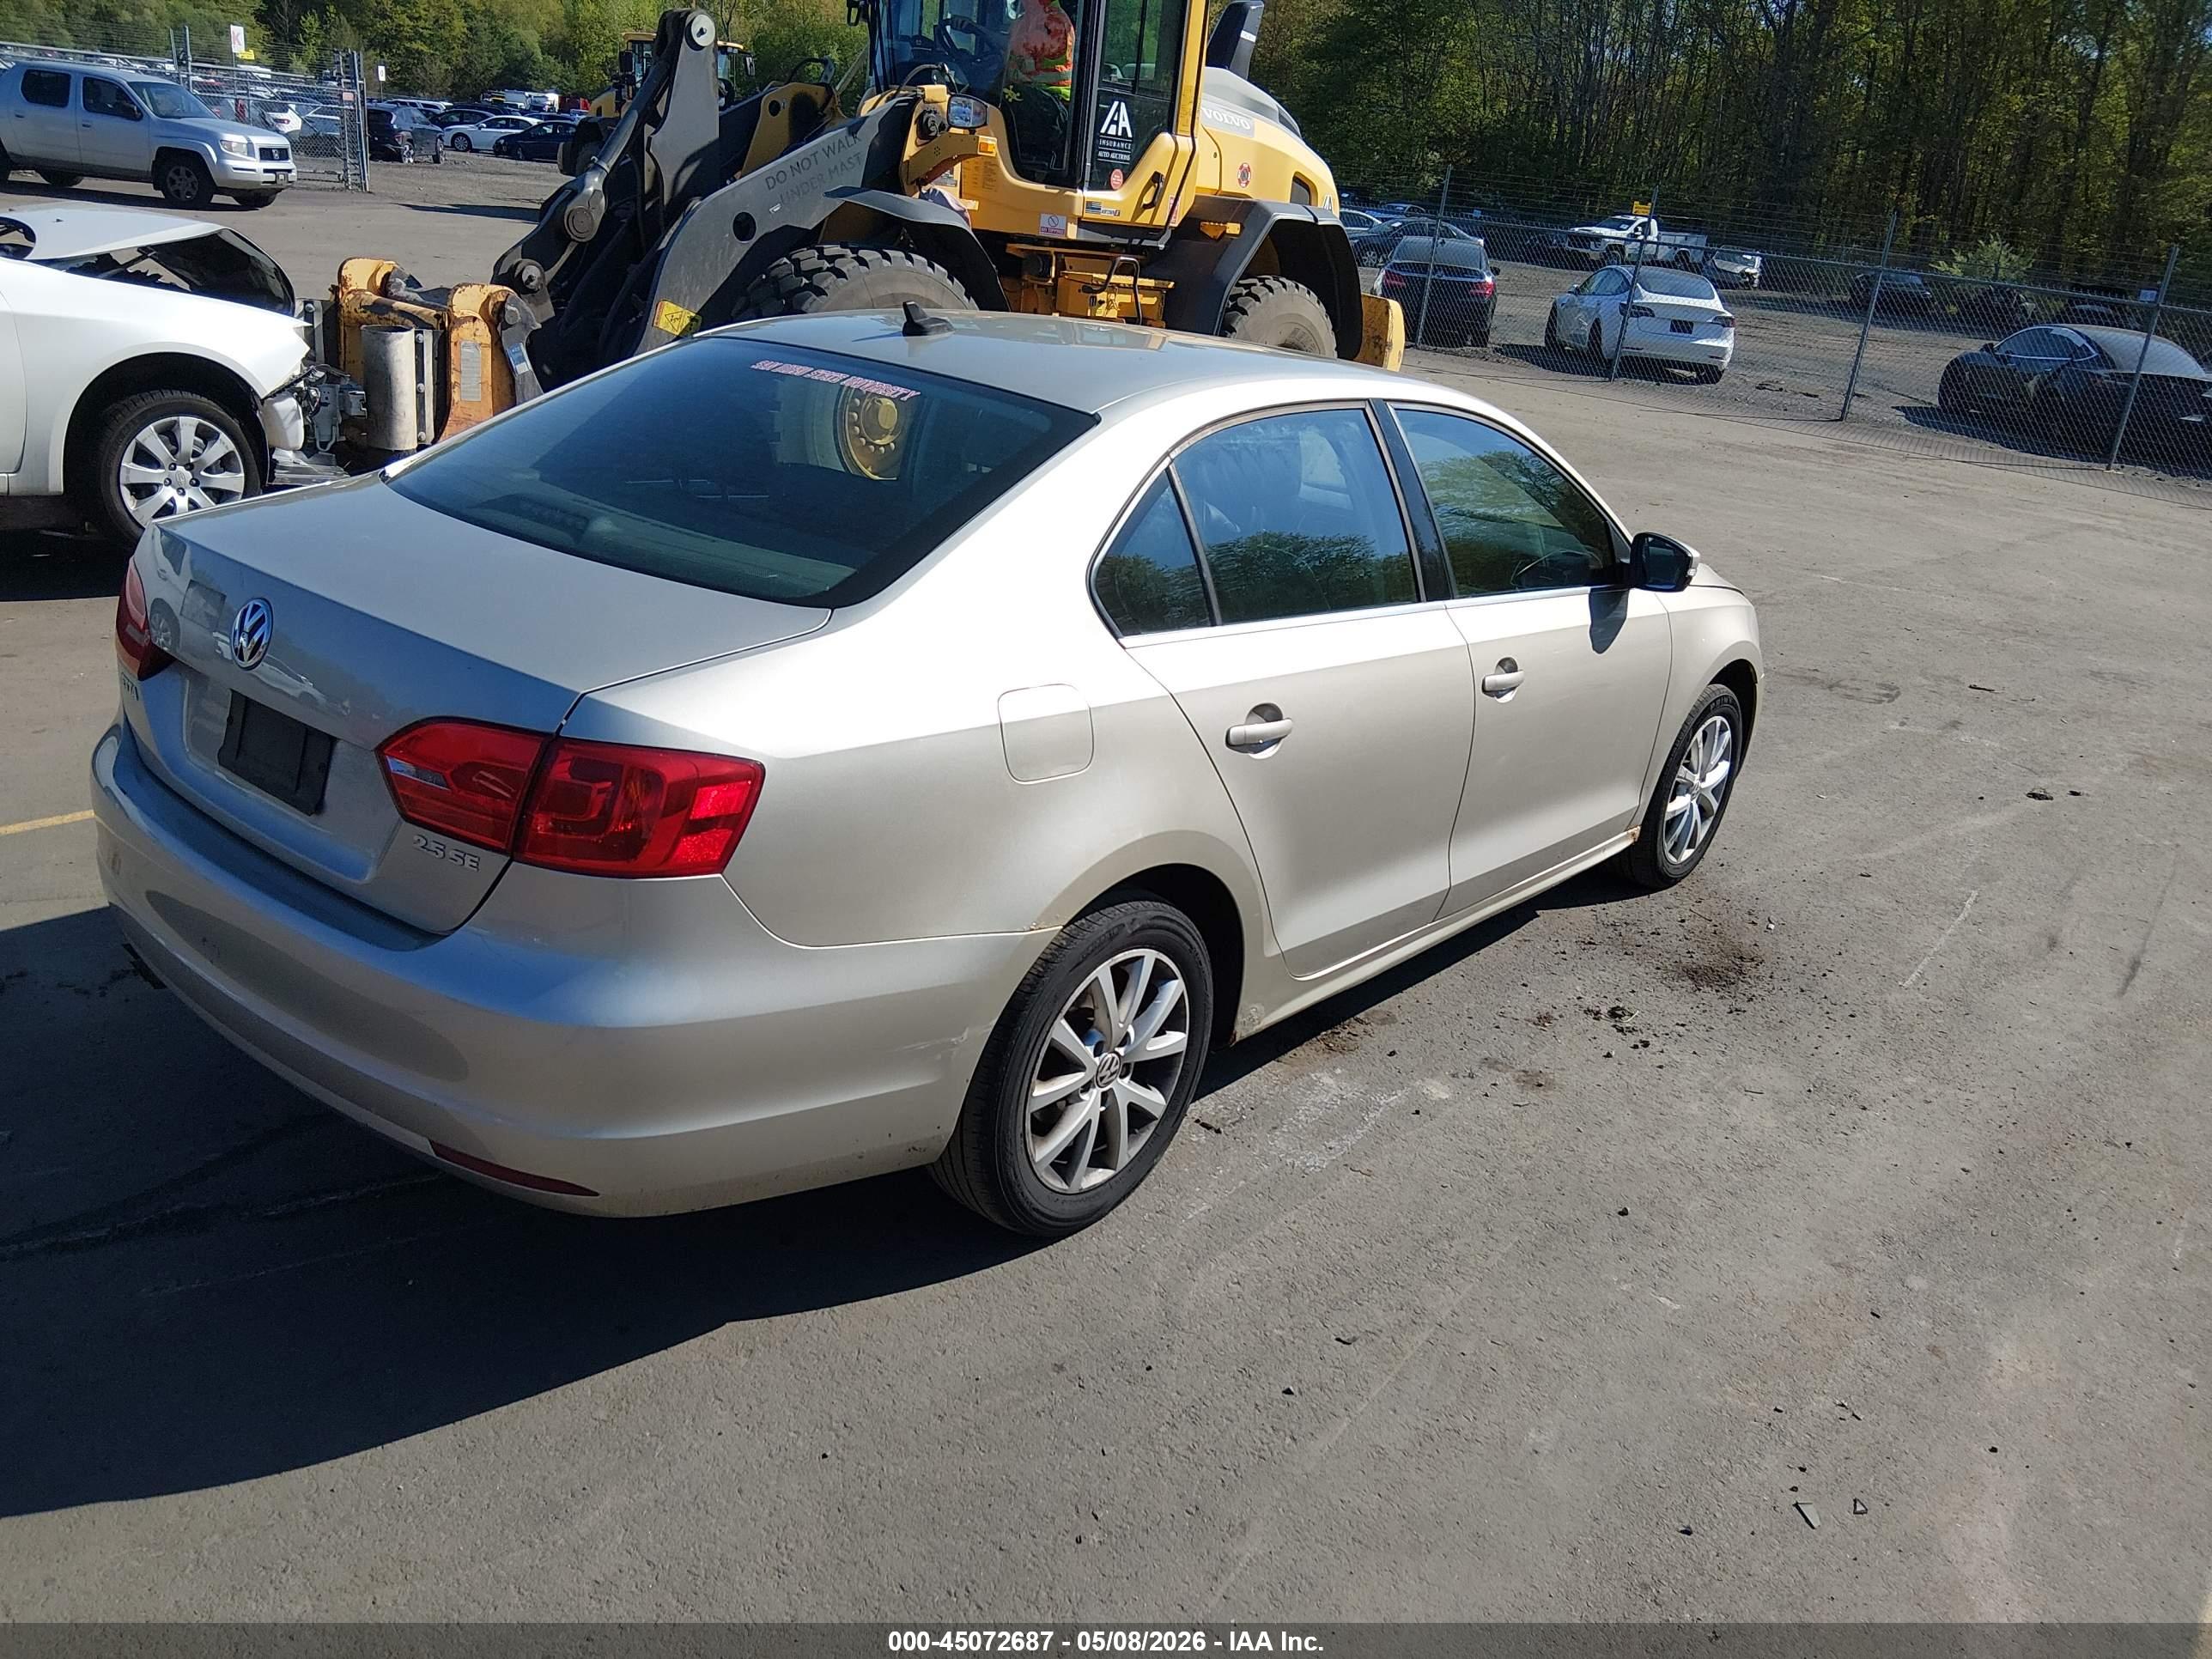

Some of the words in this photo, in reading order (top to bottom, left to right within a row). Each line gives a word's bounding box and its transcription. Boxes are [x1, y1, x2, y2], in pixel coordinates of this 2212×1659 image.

[1200, 108, 1251, 130] VOLVO
[1099, 138, 1132, 149] INSURANCE
[765, 170, 787, 191] DO
[790, 150, 819, 177] NOT
[822, 132, 862, 159] WALK
[1109, 152, 1131, 161] AUCTIONS
[780, 173, 825, 206] UNDER
[828, 152, 862, 179] MAST
[448, 848, 481, 872] SE
